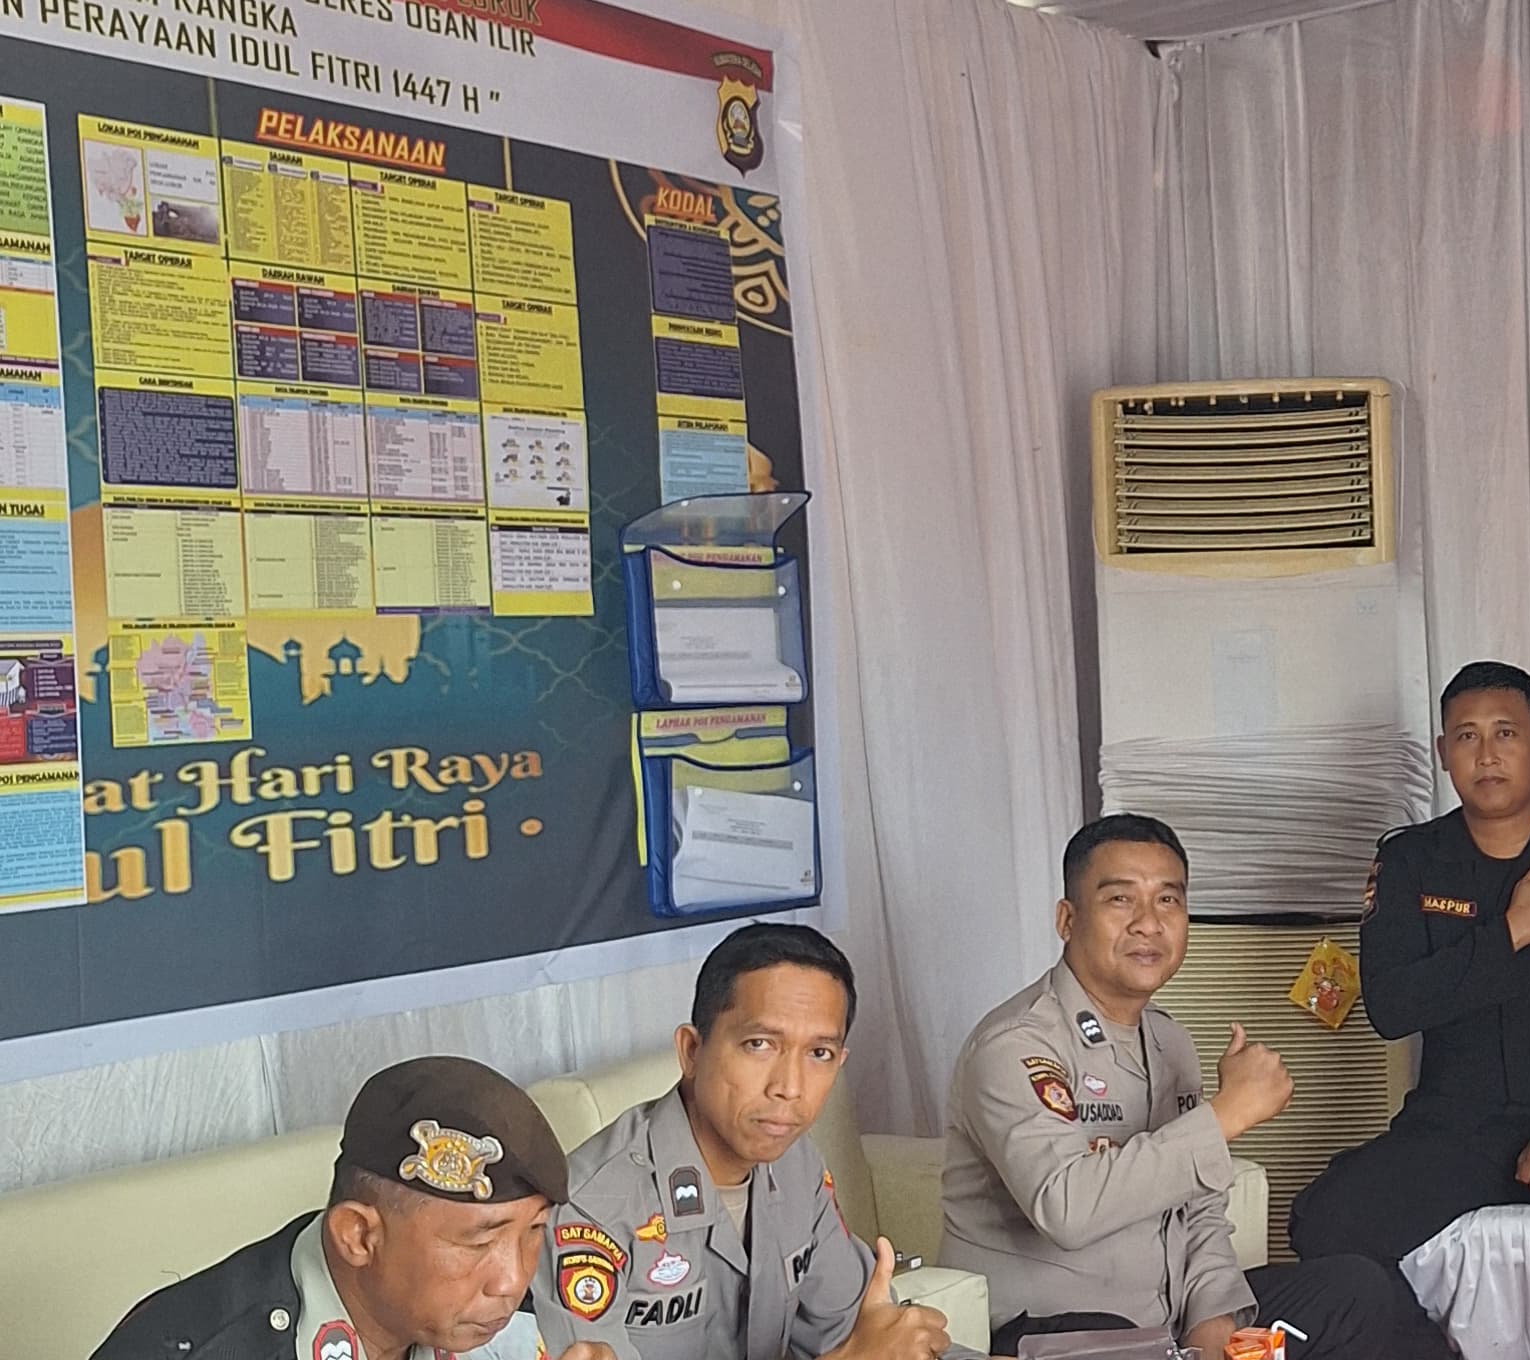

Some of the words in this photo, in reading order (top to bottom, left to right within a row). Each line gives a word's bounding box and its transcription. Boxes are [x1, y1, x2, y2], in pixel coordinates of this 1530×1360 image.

[405, 0, 479, 43] OGAN
[488, 22, 537, 58] ILIR
[230, 33, 300, 77] IDUL
[311, 51, 381, 94] FITRI
[392, 68, 450, 108] 1447
[462, 85, 481, 114] H
[256, 107, 446, 167] PELAKSANAAN
[656, 188, 717, 217] KODAL
[176, 747, 353, 817] Hari
[371, 745, 544, 793] Raya
[230, 799, 490, 883] Fitri
[625, 1287, 704, 1327] FADLI
